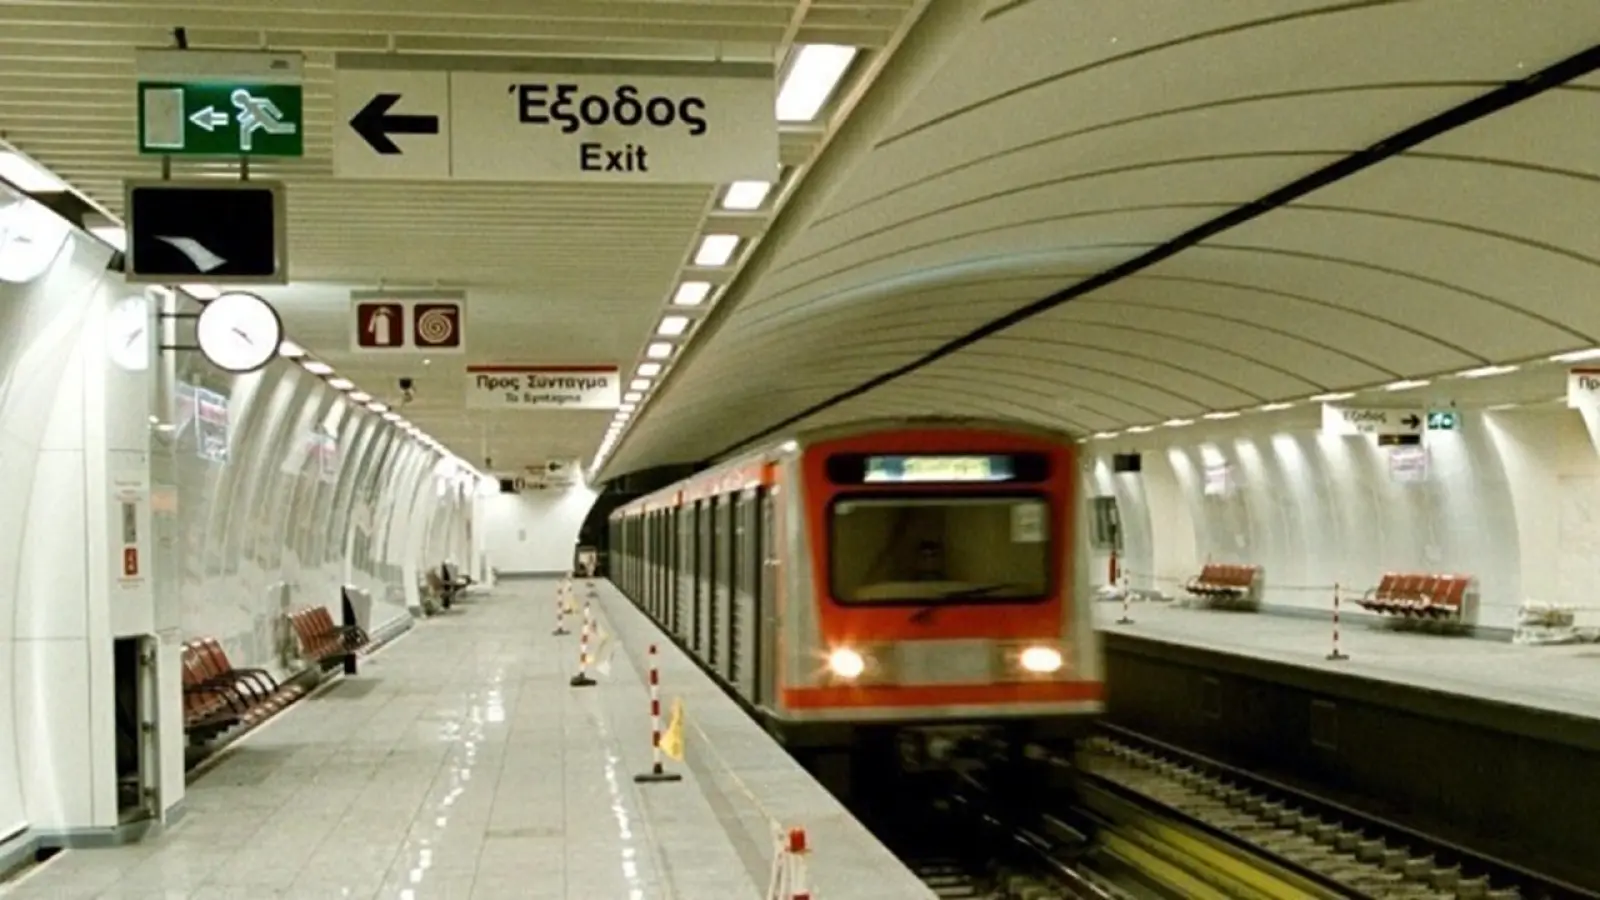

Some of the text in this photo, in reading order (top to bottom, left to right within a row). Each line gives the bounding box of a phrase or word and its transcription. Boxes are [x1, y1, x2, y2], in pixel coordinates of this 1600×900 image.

[507, 84, 708, 136] Έξοδος
[579, 142, 649, 172] Exit
[476, 375, 520, 390] Προς
